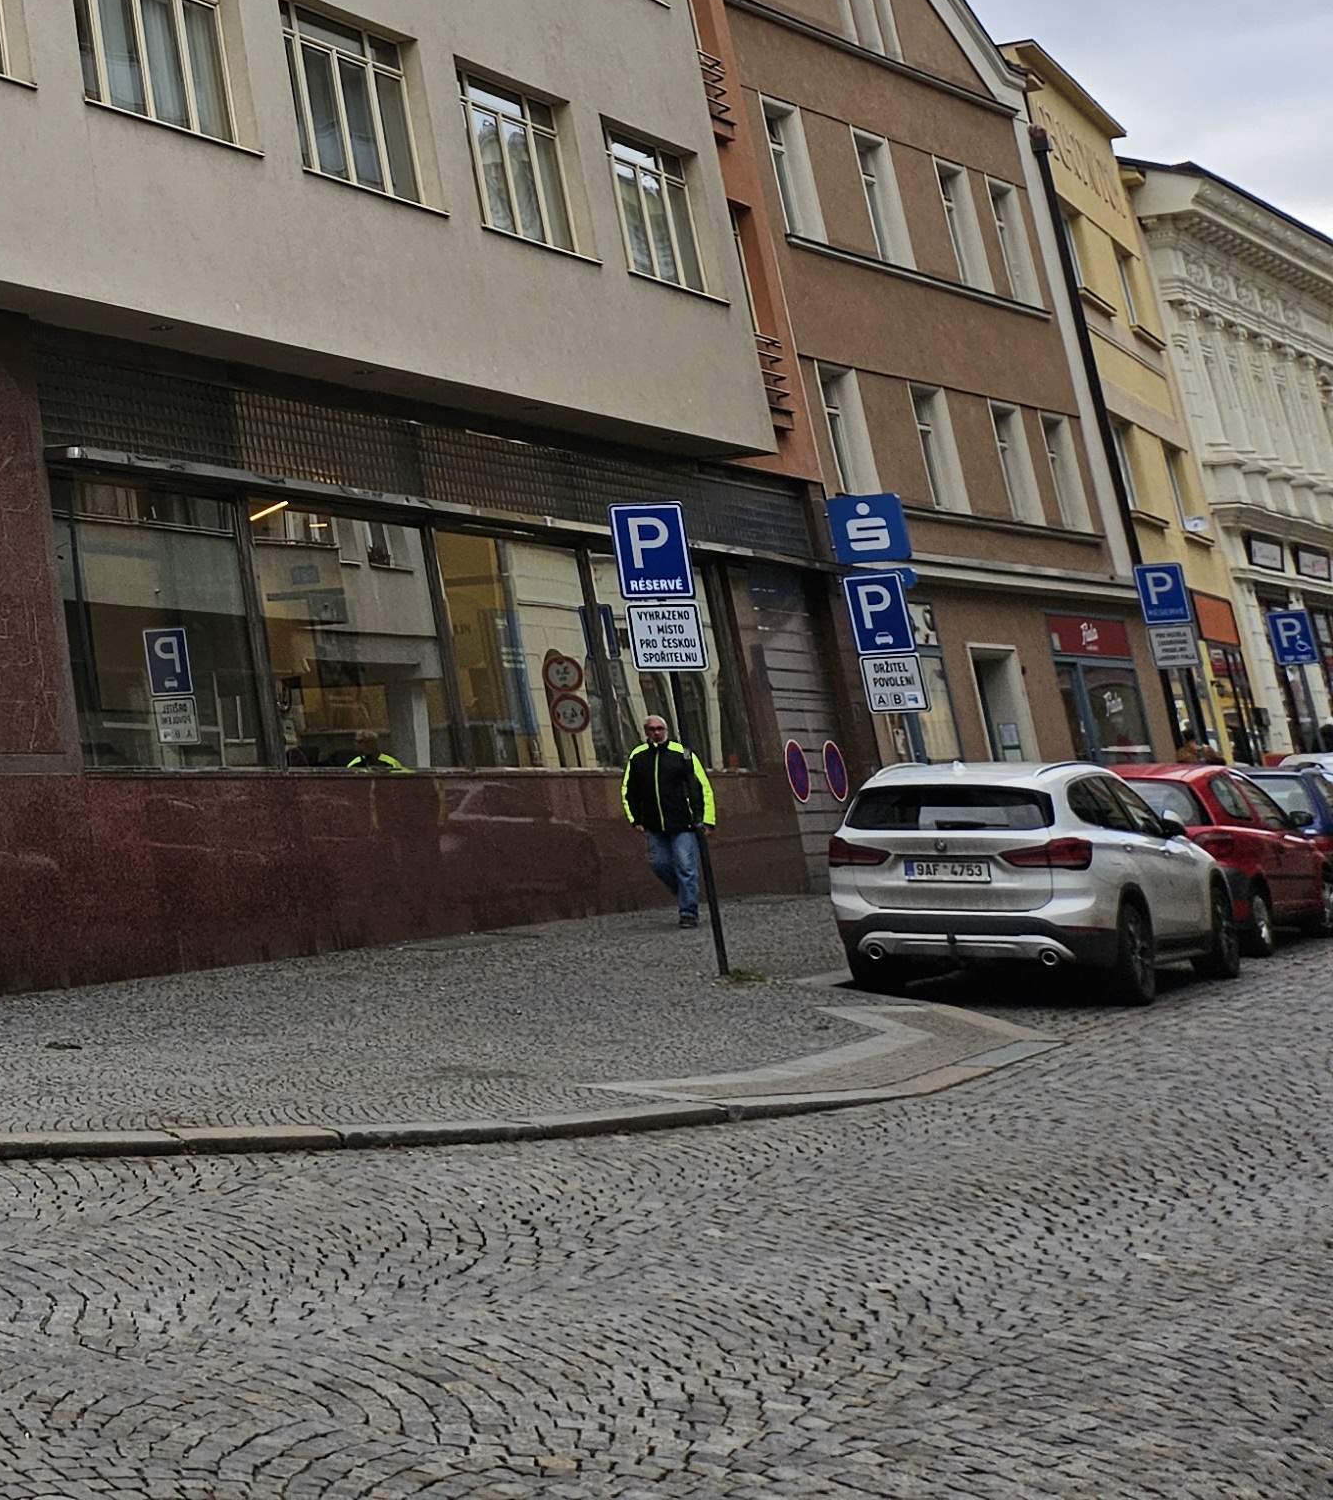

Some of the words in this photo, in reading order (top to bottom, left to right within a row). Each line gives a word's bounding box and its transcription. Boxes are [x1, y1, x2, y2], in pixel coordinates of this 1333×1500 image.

[627, 517, 669, 569] P
[630, 576, 684, 591] RÉSERVÉ
[1145, 572, 1173, 605] P
[857, 584, 892, 629] P
[637, 610, 690, 621] VYHRAZENO
[657, 622, 684, 635] MÍSTO
[1276, 617, 1302, 648] P
[640, 638, 658, 649] PRO
[661, 632, 696, 649] ČESKOU
[643, 651, 698, 663] SPOŘITELNU
[873, 660, 909, 674] DRŽITEL
[873, 673, 915, 688] POVOLENÍ
[877, 695, 887, 705] A
[893, 694, 902, 705] B
[916, 863, 939, 876] 9AF
[950, 864, 983, 877] 4753
